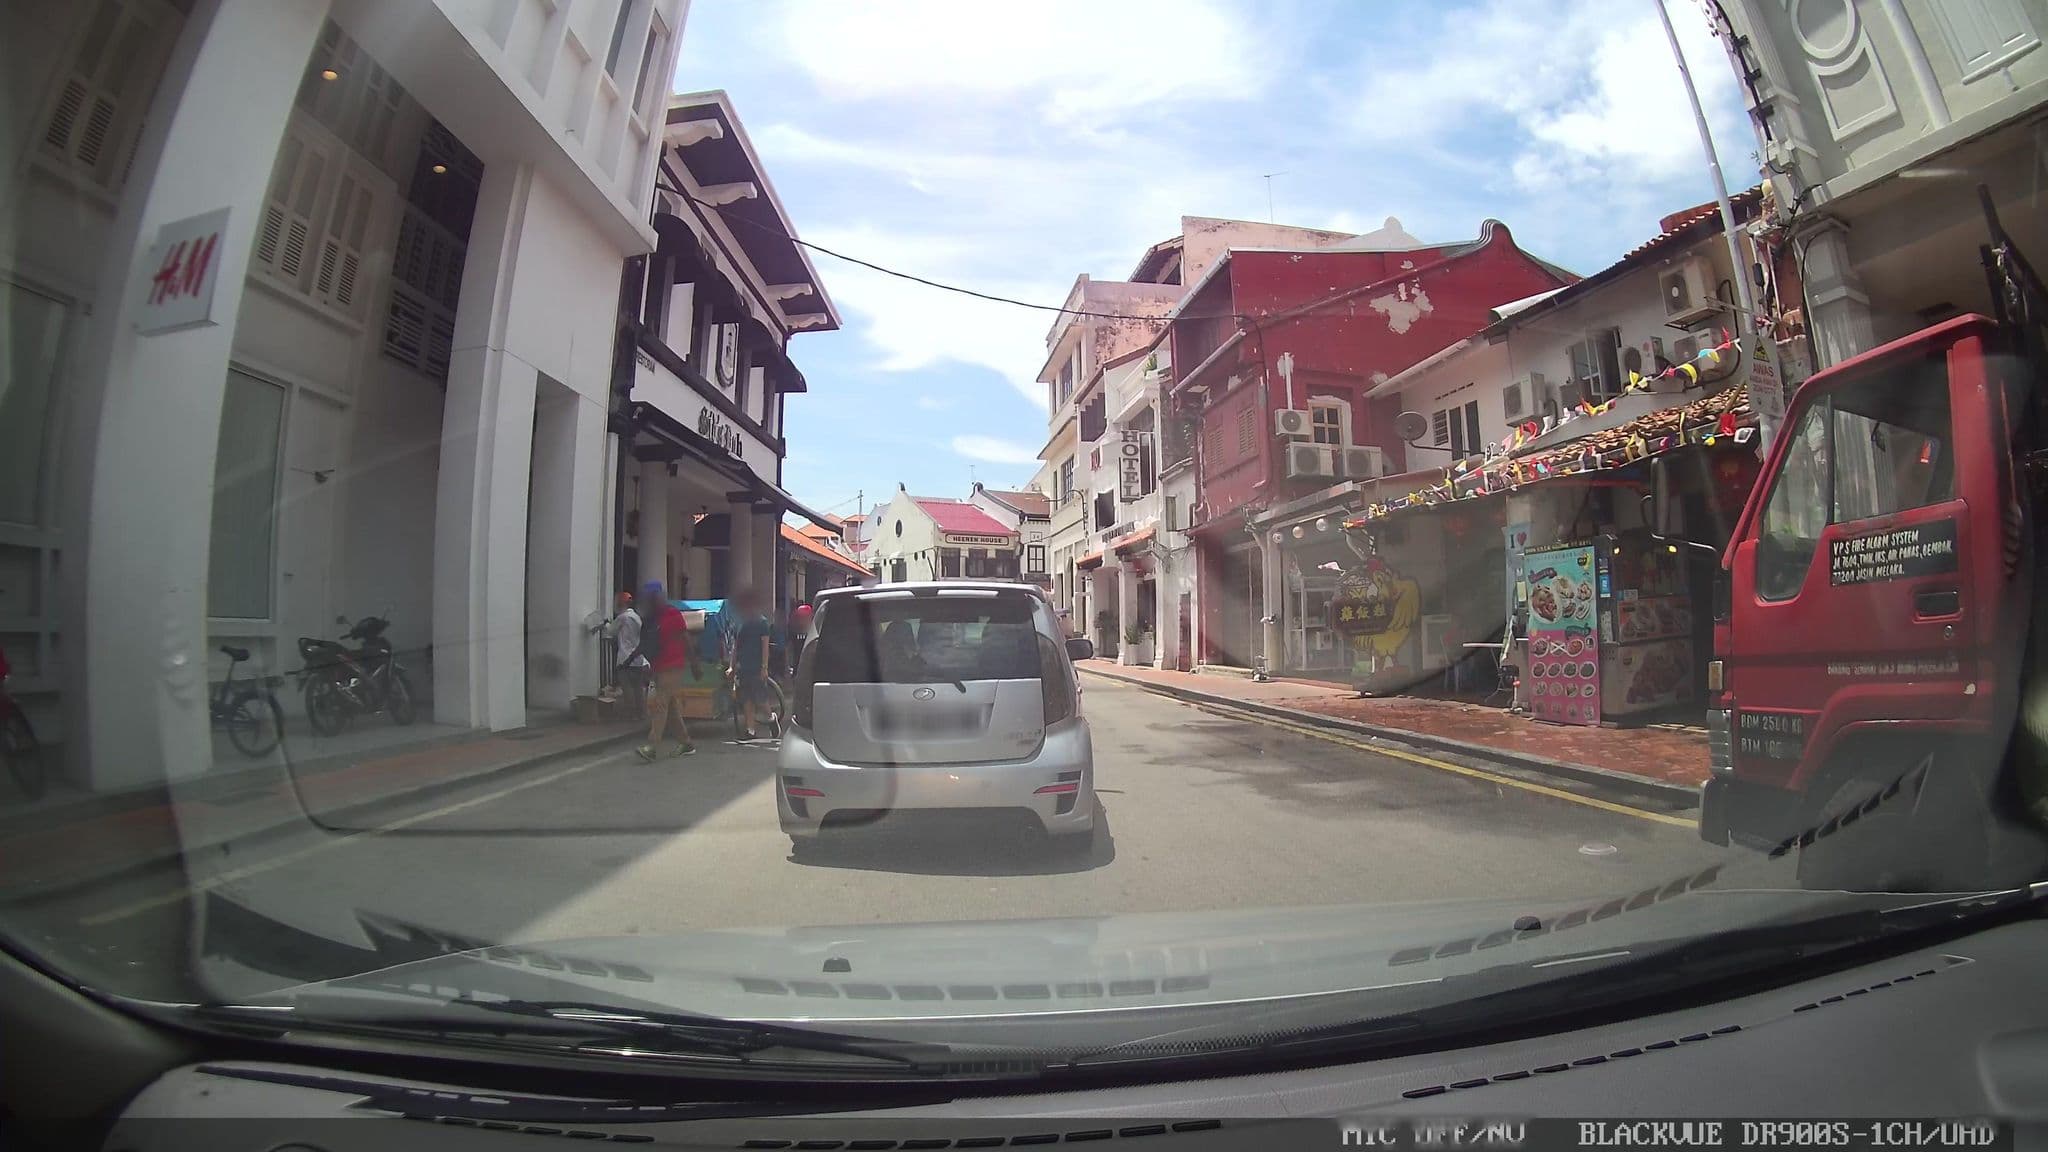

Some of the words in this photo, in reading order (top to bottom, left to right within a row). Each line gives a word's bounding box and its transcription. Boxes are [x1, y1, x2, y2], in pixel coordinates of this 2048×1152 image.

[147, 232, 218, 305] H&M
[1752, 362, 1775, 377] AWAS
[1120, 430, 1140, 498] HOTEL
[953, 535, 979, 543] HEEREN
[981, 536, 1002, 544] HOUSE
[1851, 538, 1866, 553] FIRE
[1866, 534, 1889, 550] ALARM
[1890, 530, 1919, 546] SYSTEM
[1741, 737, 1760, 753] BTM
